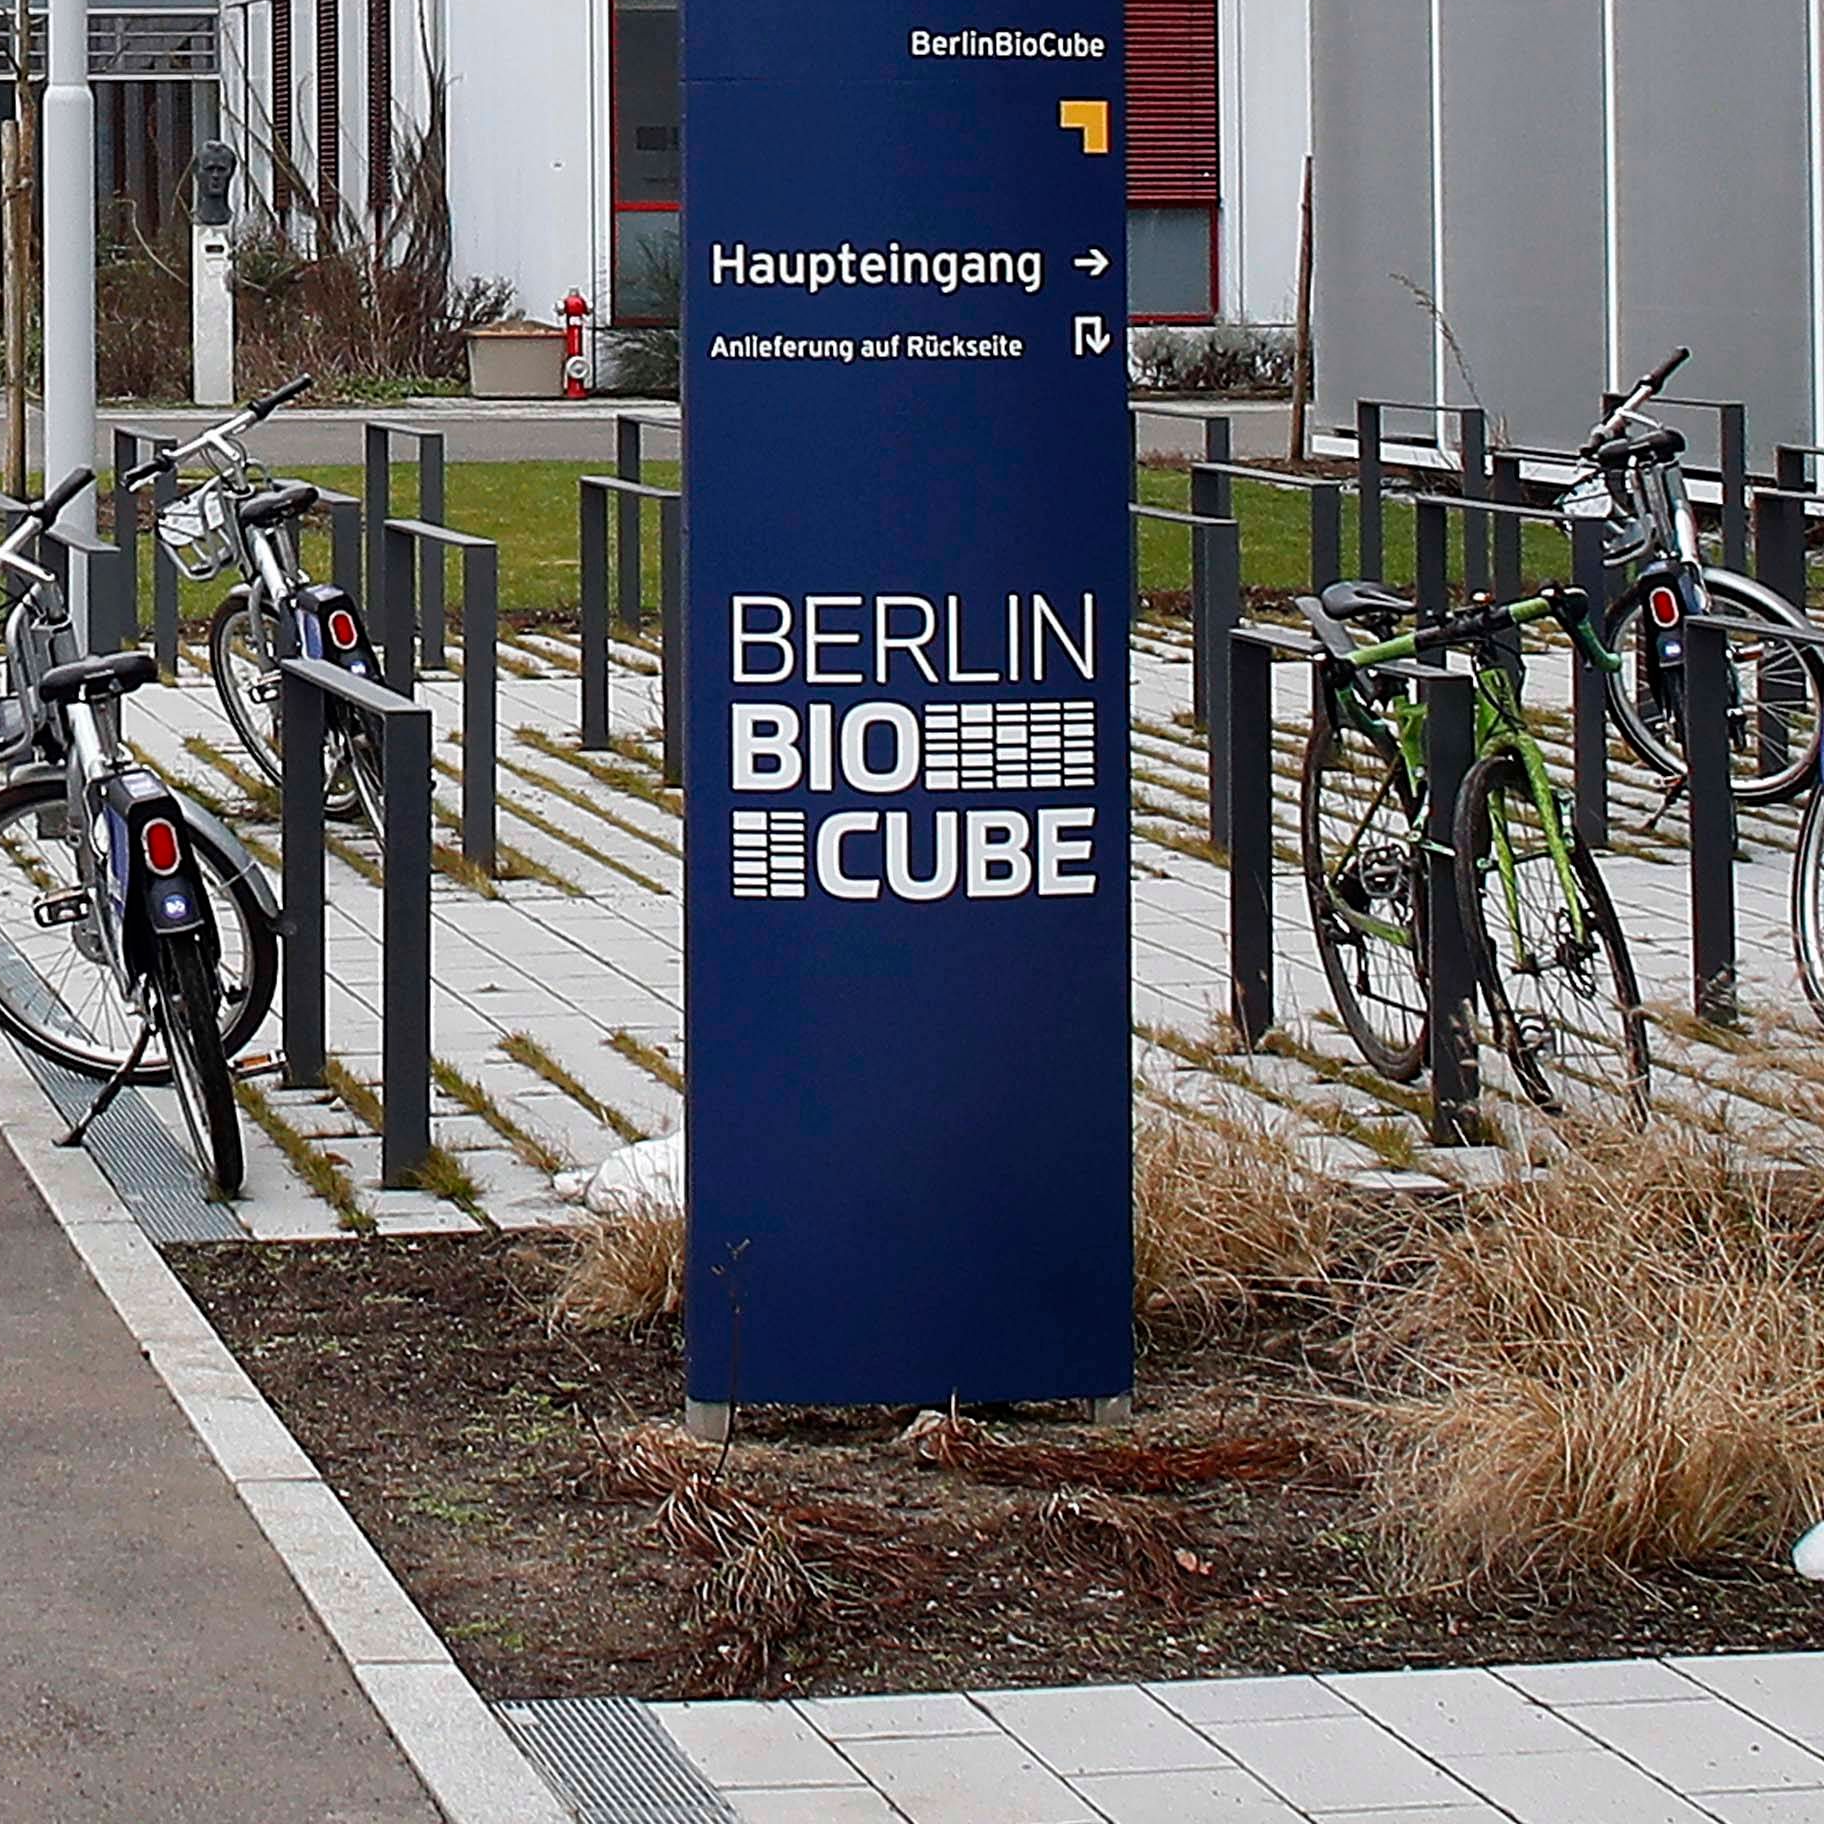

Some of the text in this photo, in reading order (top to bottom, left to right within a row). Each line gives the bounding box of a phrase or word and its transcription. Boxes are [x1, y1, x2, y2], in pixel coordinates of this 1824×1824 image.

[911, 30, 1105, 58] BerlinBioCube
[712, 242, 1042, 294] Haupteingang
[710, 333, 1023, 364] Anlieferung auf Rückseite
[732, 593, 1095, 684] BERLIN
[731, 702, 921, 793] BIO
[816, 807, 1097, 900] CUBE
